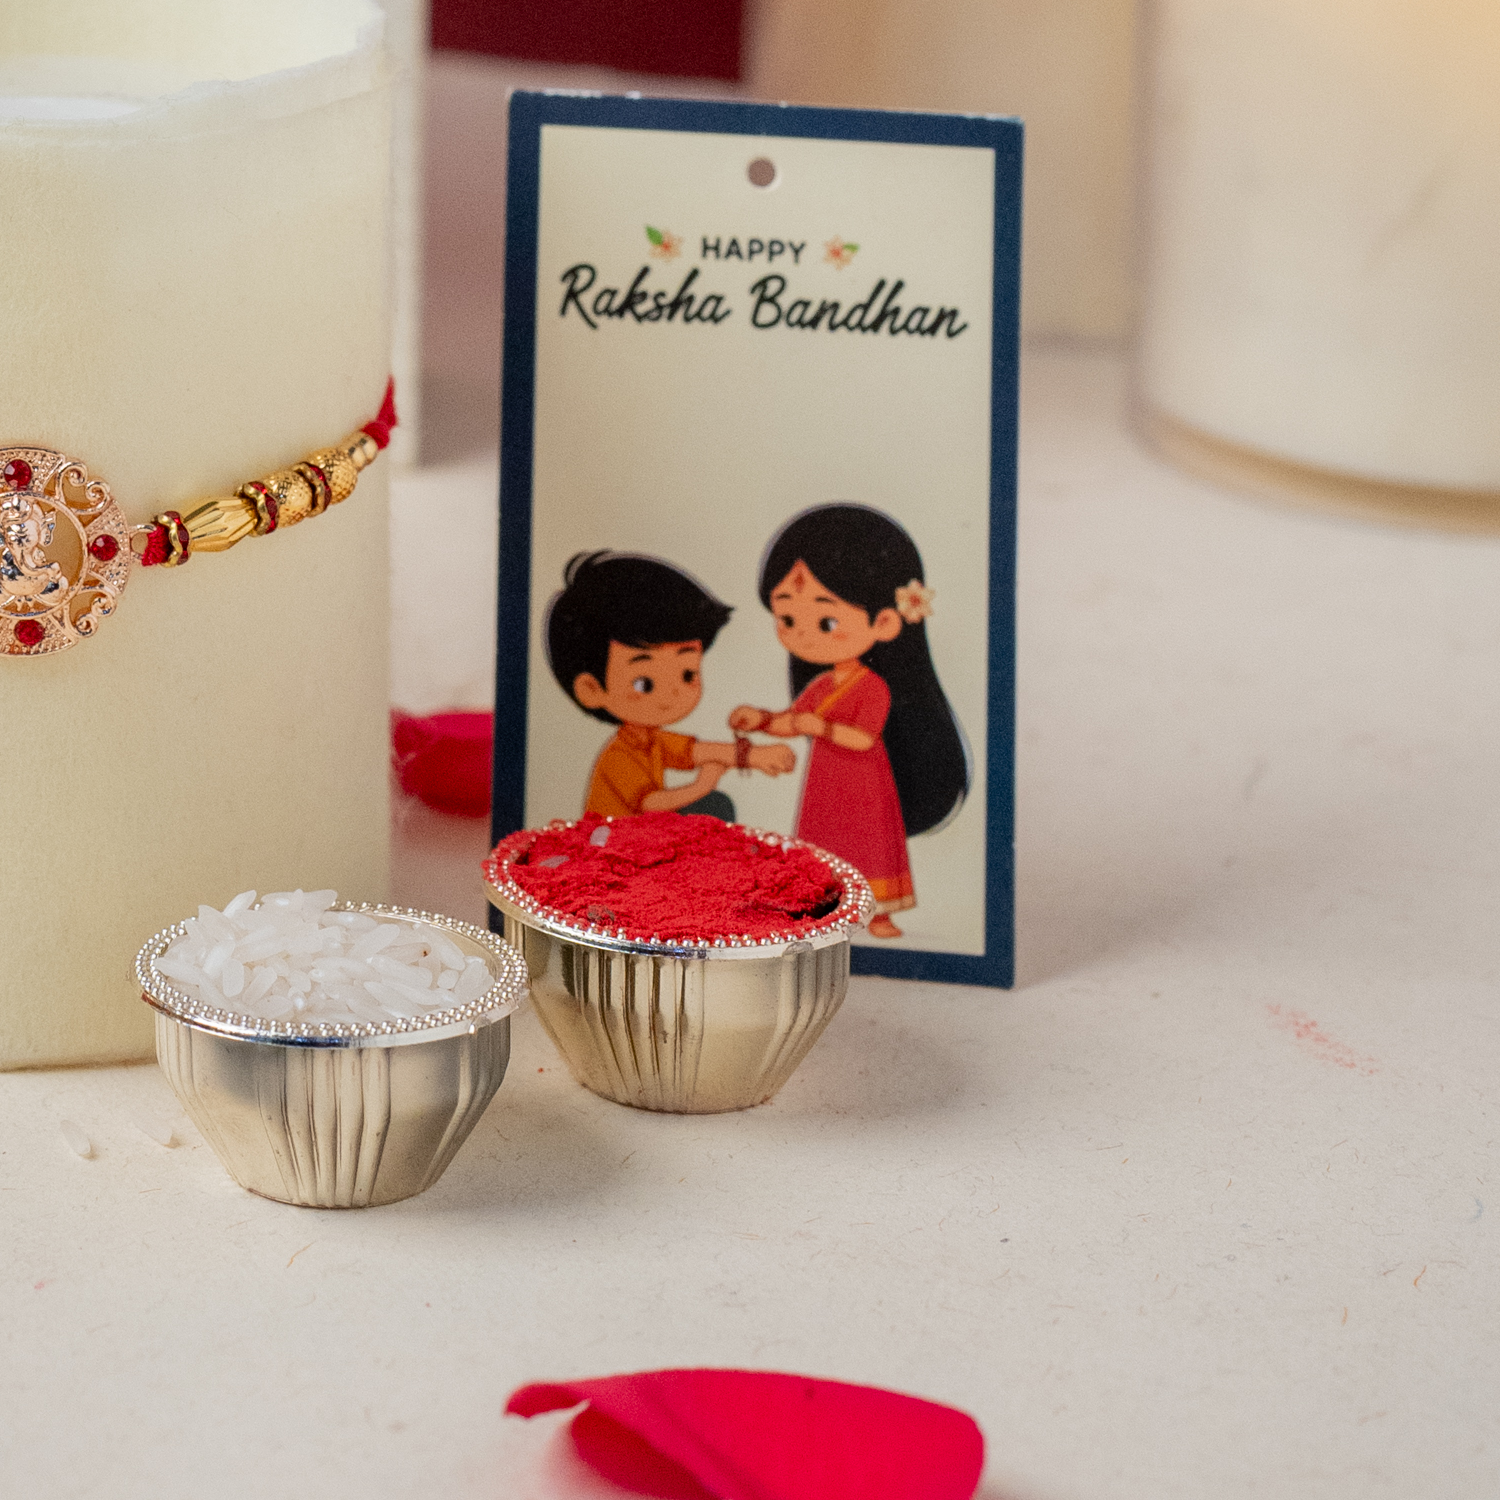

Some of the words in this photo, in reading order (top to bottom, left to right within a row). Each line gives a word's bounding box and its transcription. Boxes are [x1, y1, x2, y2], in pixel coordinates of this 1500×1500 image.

[701, 237, 806, 264] HAPPY
[559, 263, 733, 330] Raksha
[749, 274, 970, 338] Bandhan
